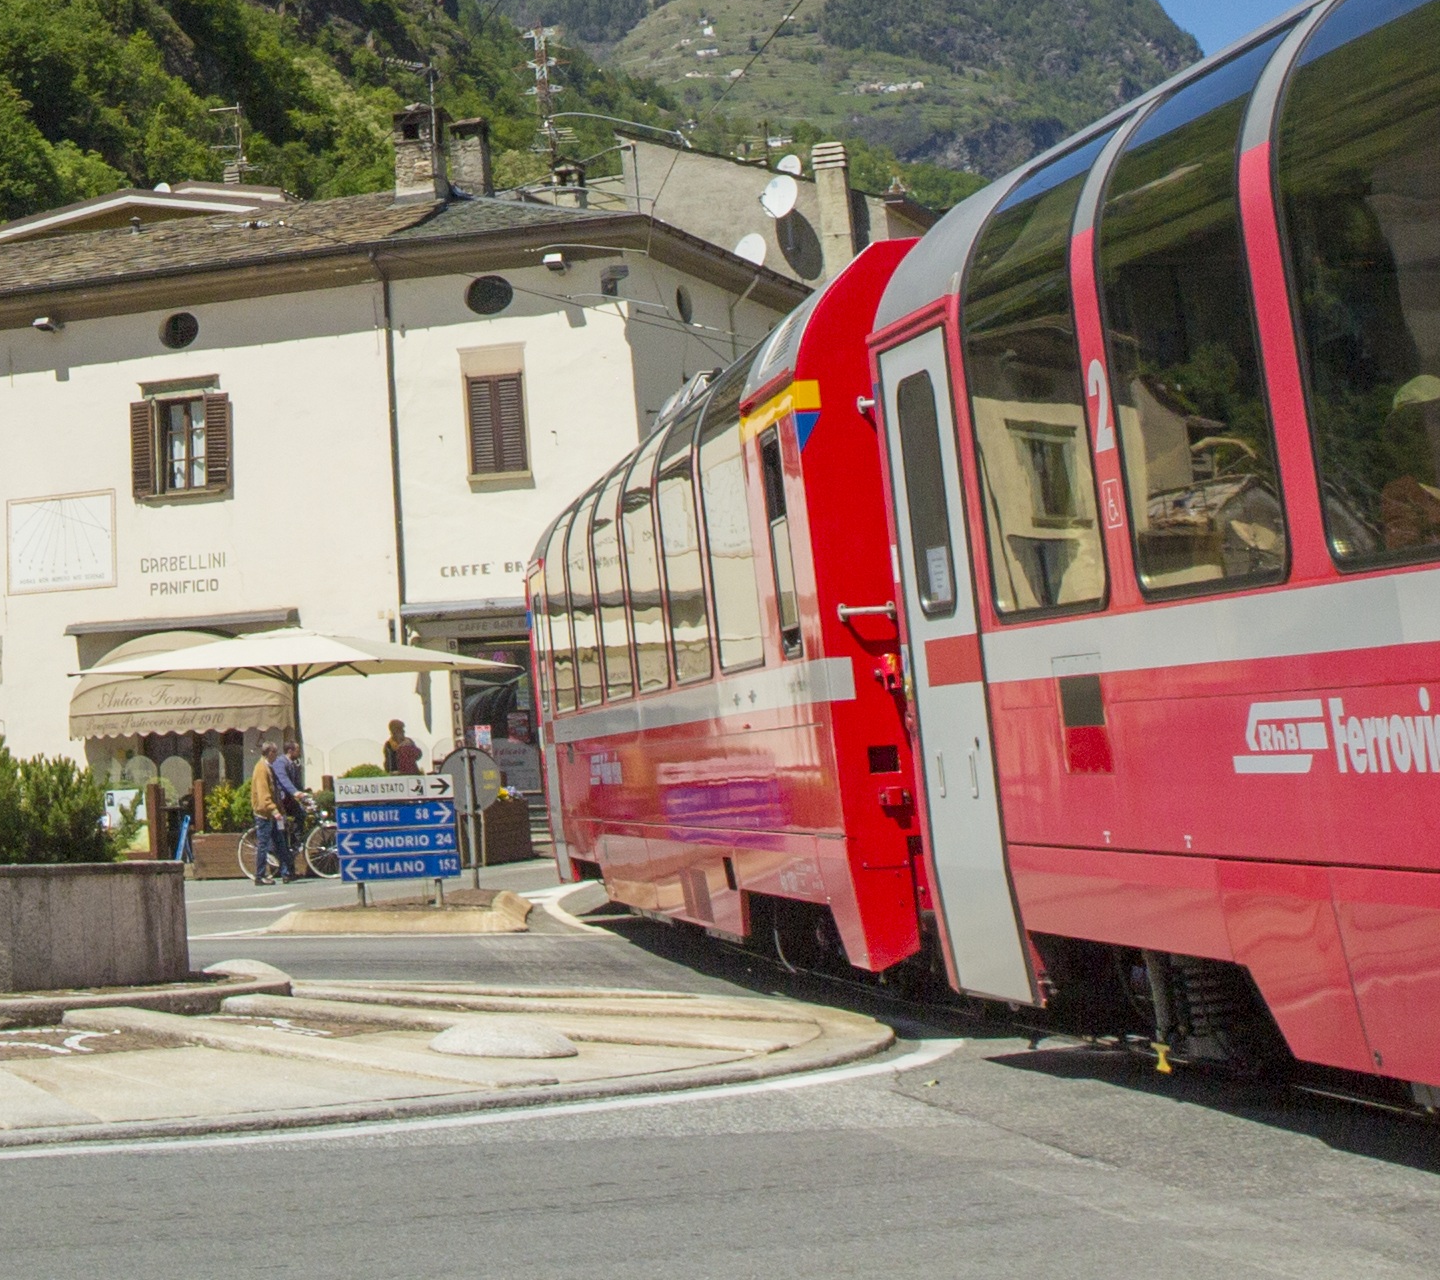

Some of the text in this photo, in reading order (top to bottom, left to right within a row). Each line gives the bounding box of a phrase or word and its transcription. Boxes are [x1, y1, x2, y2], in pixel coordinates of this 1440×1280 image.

[1087, 358, 1115, 453] 2
[504, 561, 525, 573] BA
[150, 578, 219, 596] PANIFICIO
[97, 684, 202, 710] Antico Forno
[198, 712, 225, 724] 1910
[1258, 723, 1300, 751] RhB
[339, 783, 404, 795] POLIZIA DI STATO
[363, 809, 400, 822] MORITZ
[415, 808, 429, 819] 58
[365, 833, 452, 849] SONDRIO 24
[367, 858, 457, 874] MILANO 152
